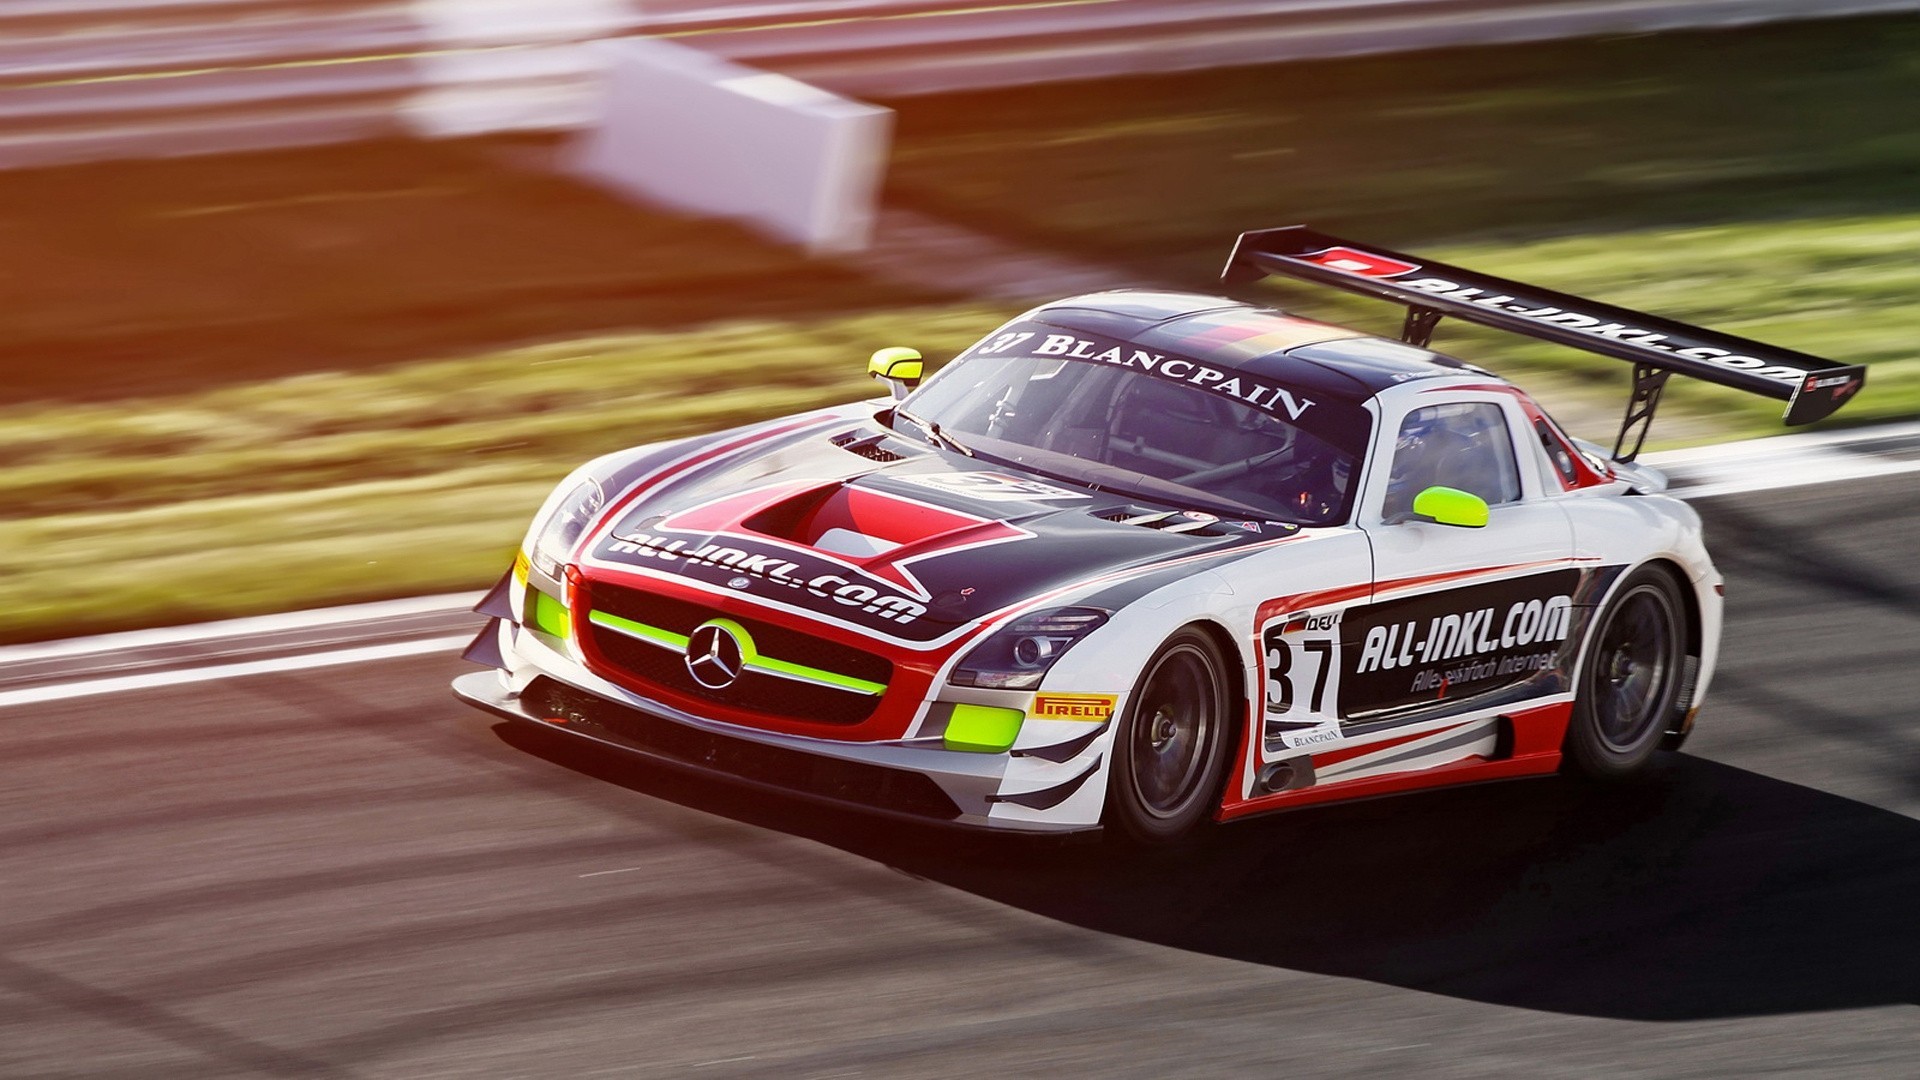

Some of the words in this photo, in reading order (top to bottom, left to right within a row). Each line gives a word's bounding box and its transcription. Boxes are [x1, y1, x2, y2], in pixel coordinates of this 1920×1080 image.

[979, 332, 1035, 355] 37
[1032, 334, 1316, 421] BLANCPAIN
[607, 533, 928, 625] ALL-INKL.COM
[1357, 595, 1573, 674] ALL-INKL.COM
[1410, 669, 1443, 692] Alles
[1496, 650, 1558, 675] Internet
[1036, 697, 1111, 717] PIRELLI
[1265, 636, 1333, 714] 37
[1294, 730, 1339, 747] BLANCPAIN
